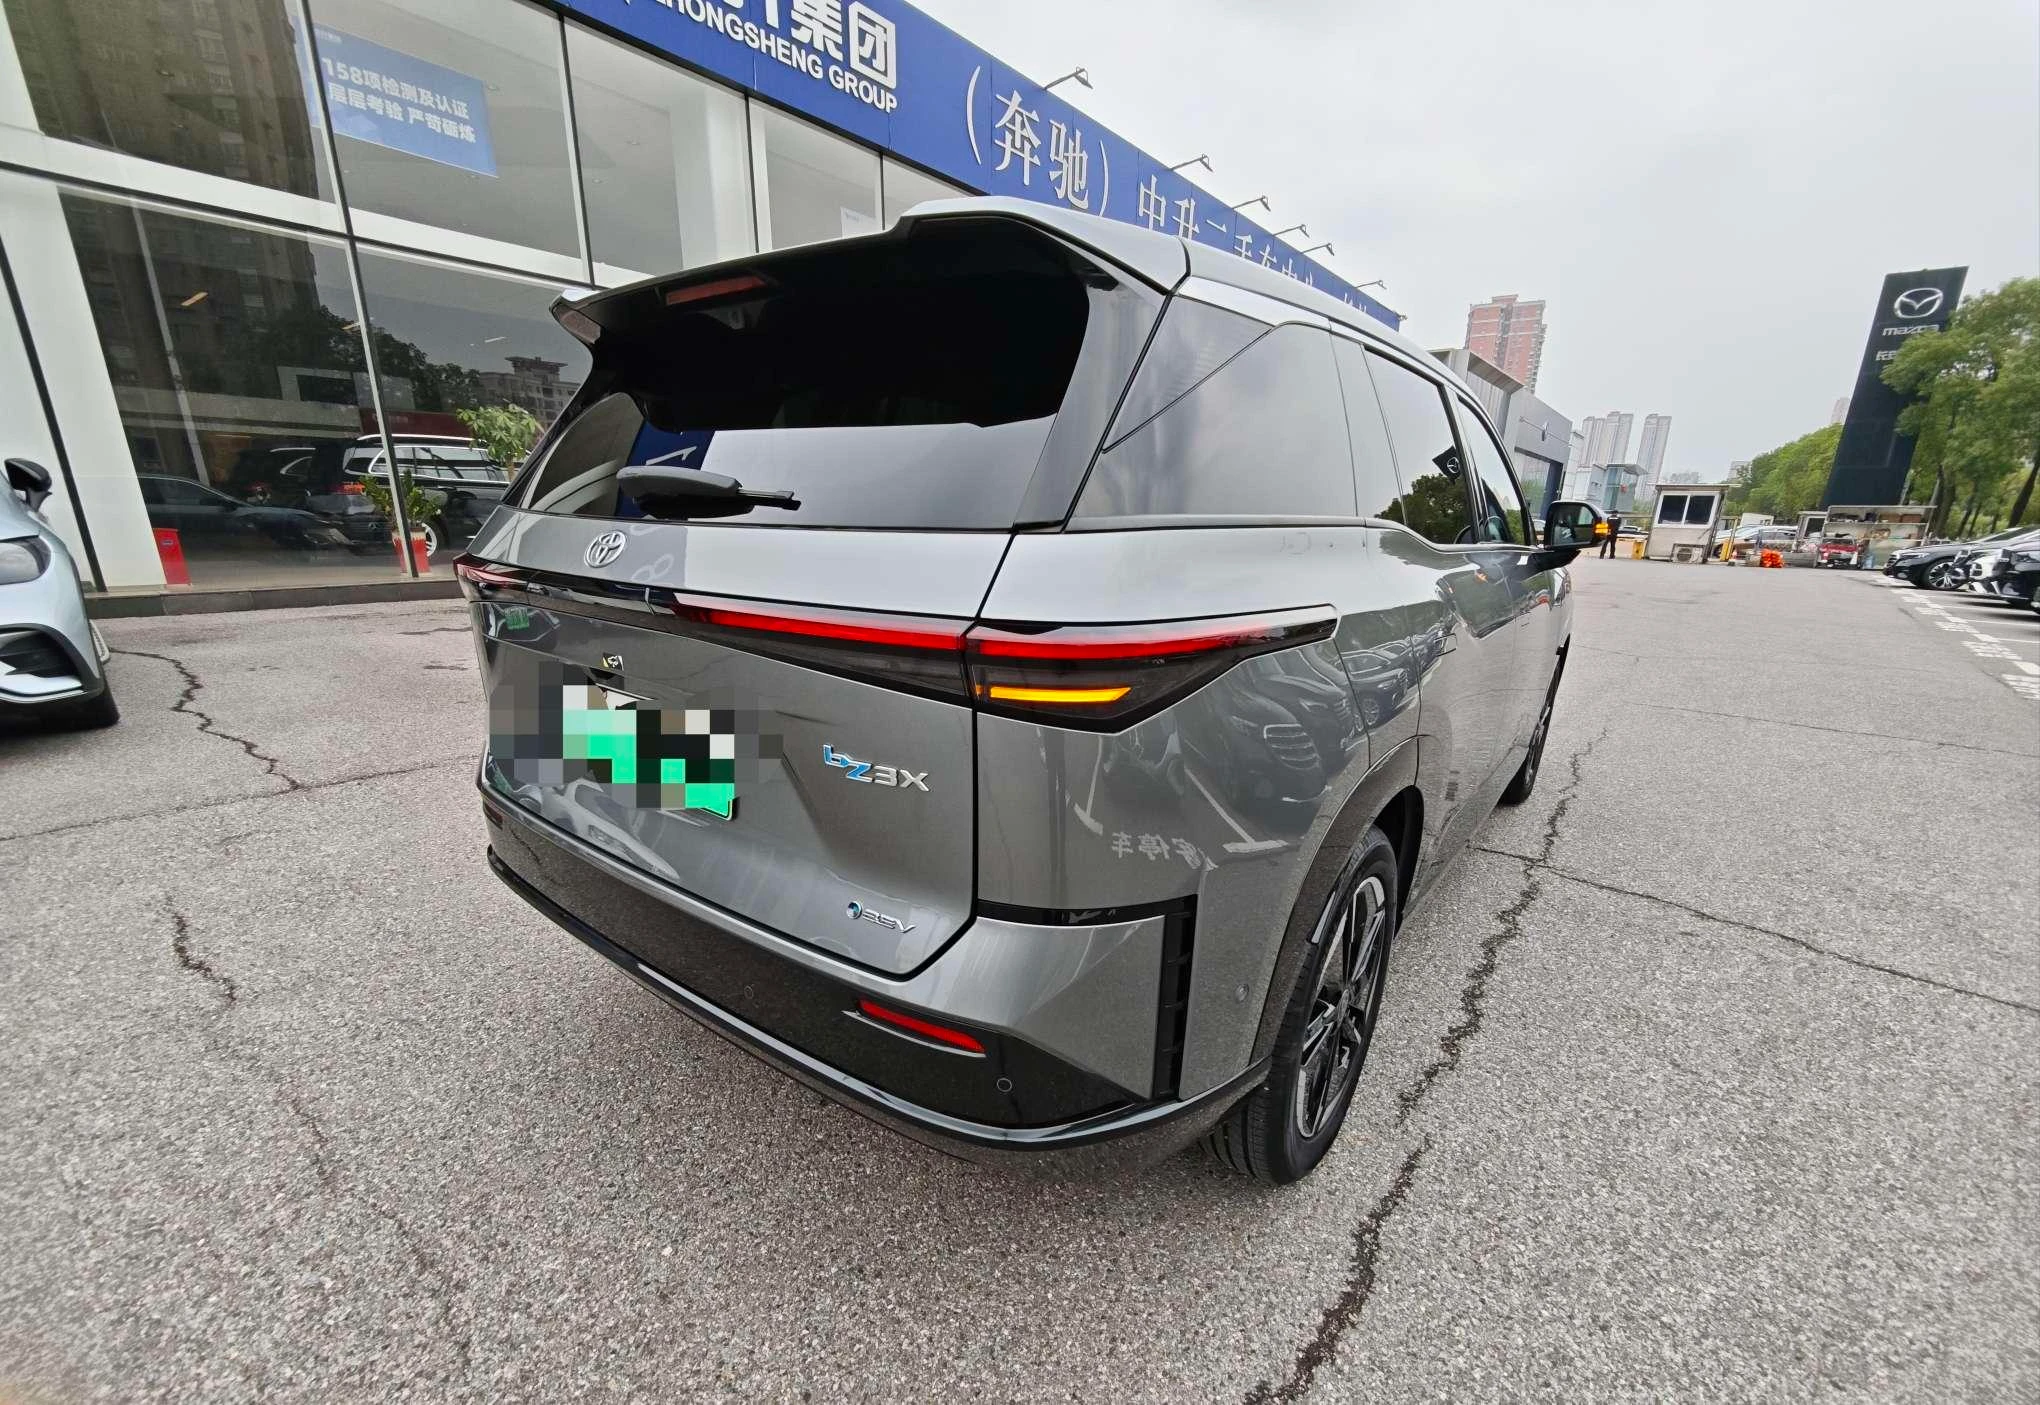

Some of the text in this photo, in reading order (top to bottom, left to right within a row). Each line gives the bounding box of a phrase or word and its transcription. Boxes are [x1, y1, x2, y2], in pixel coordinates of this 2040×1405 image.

[321, 57, 470, 120] 158项检测及认证
[656, 0, 898, 114] ONGSHENG GROUP
[823, 744, 930, 792] bZ3X
